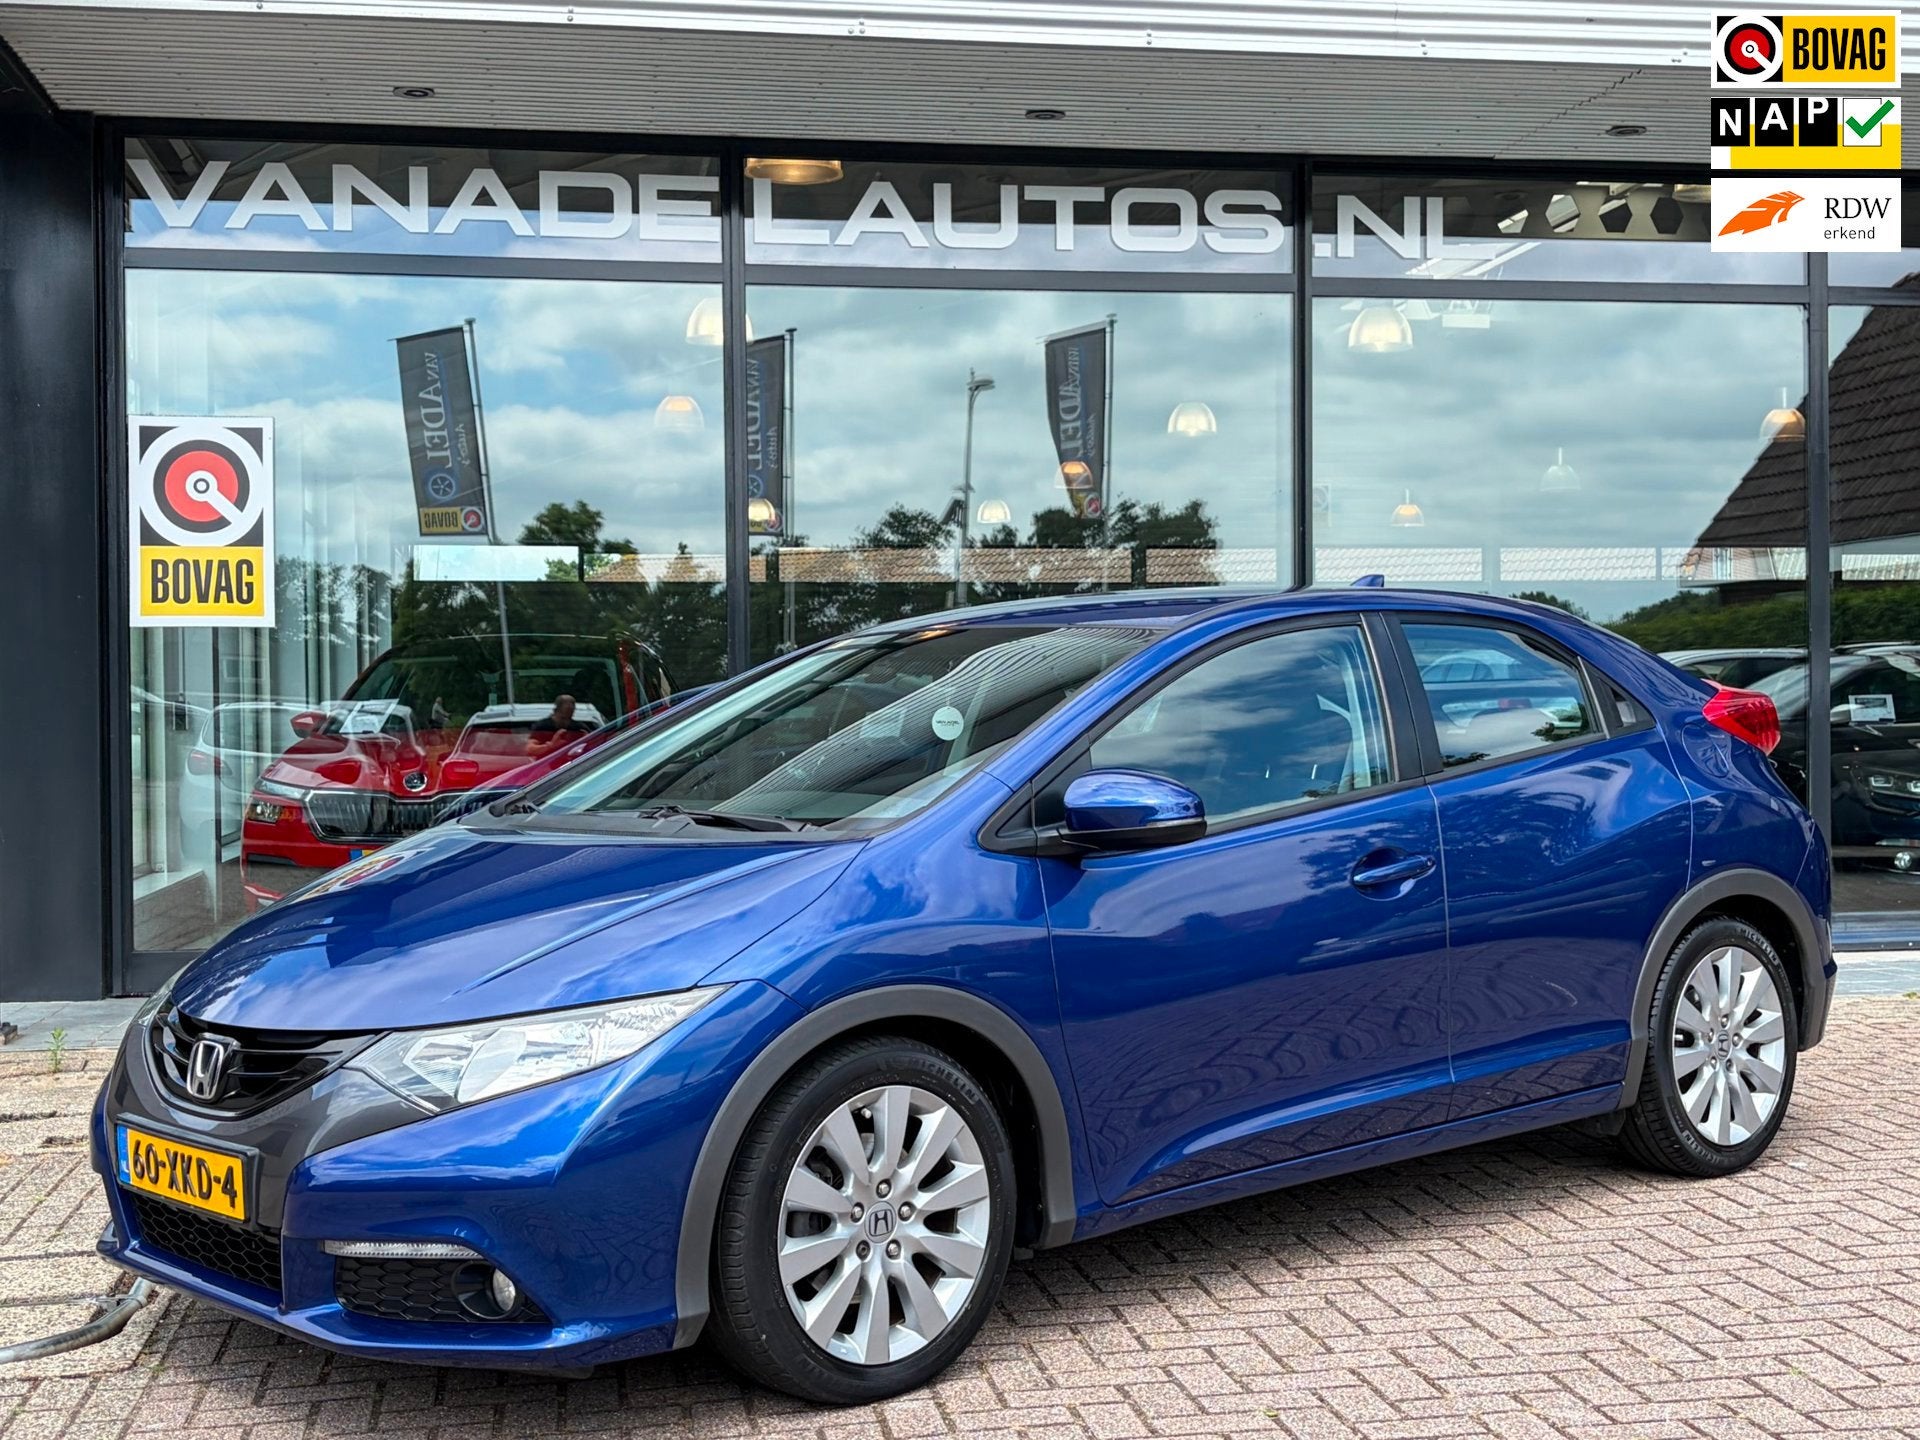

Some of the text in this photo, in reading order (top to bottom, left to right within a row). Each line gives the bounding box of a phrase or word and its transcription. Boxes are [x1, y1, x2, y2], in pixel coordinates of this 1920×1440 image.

[151, 558, 254, 605] BOVAG
[908, 1057, 976, 1101] MICHELIN
[133, 1139, 238, 1209] 60-XKD-4
